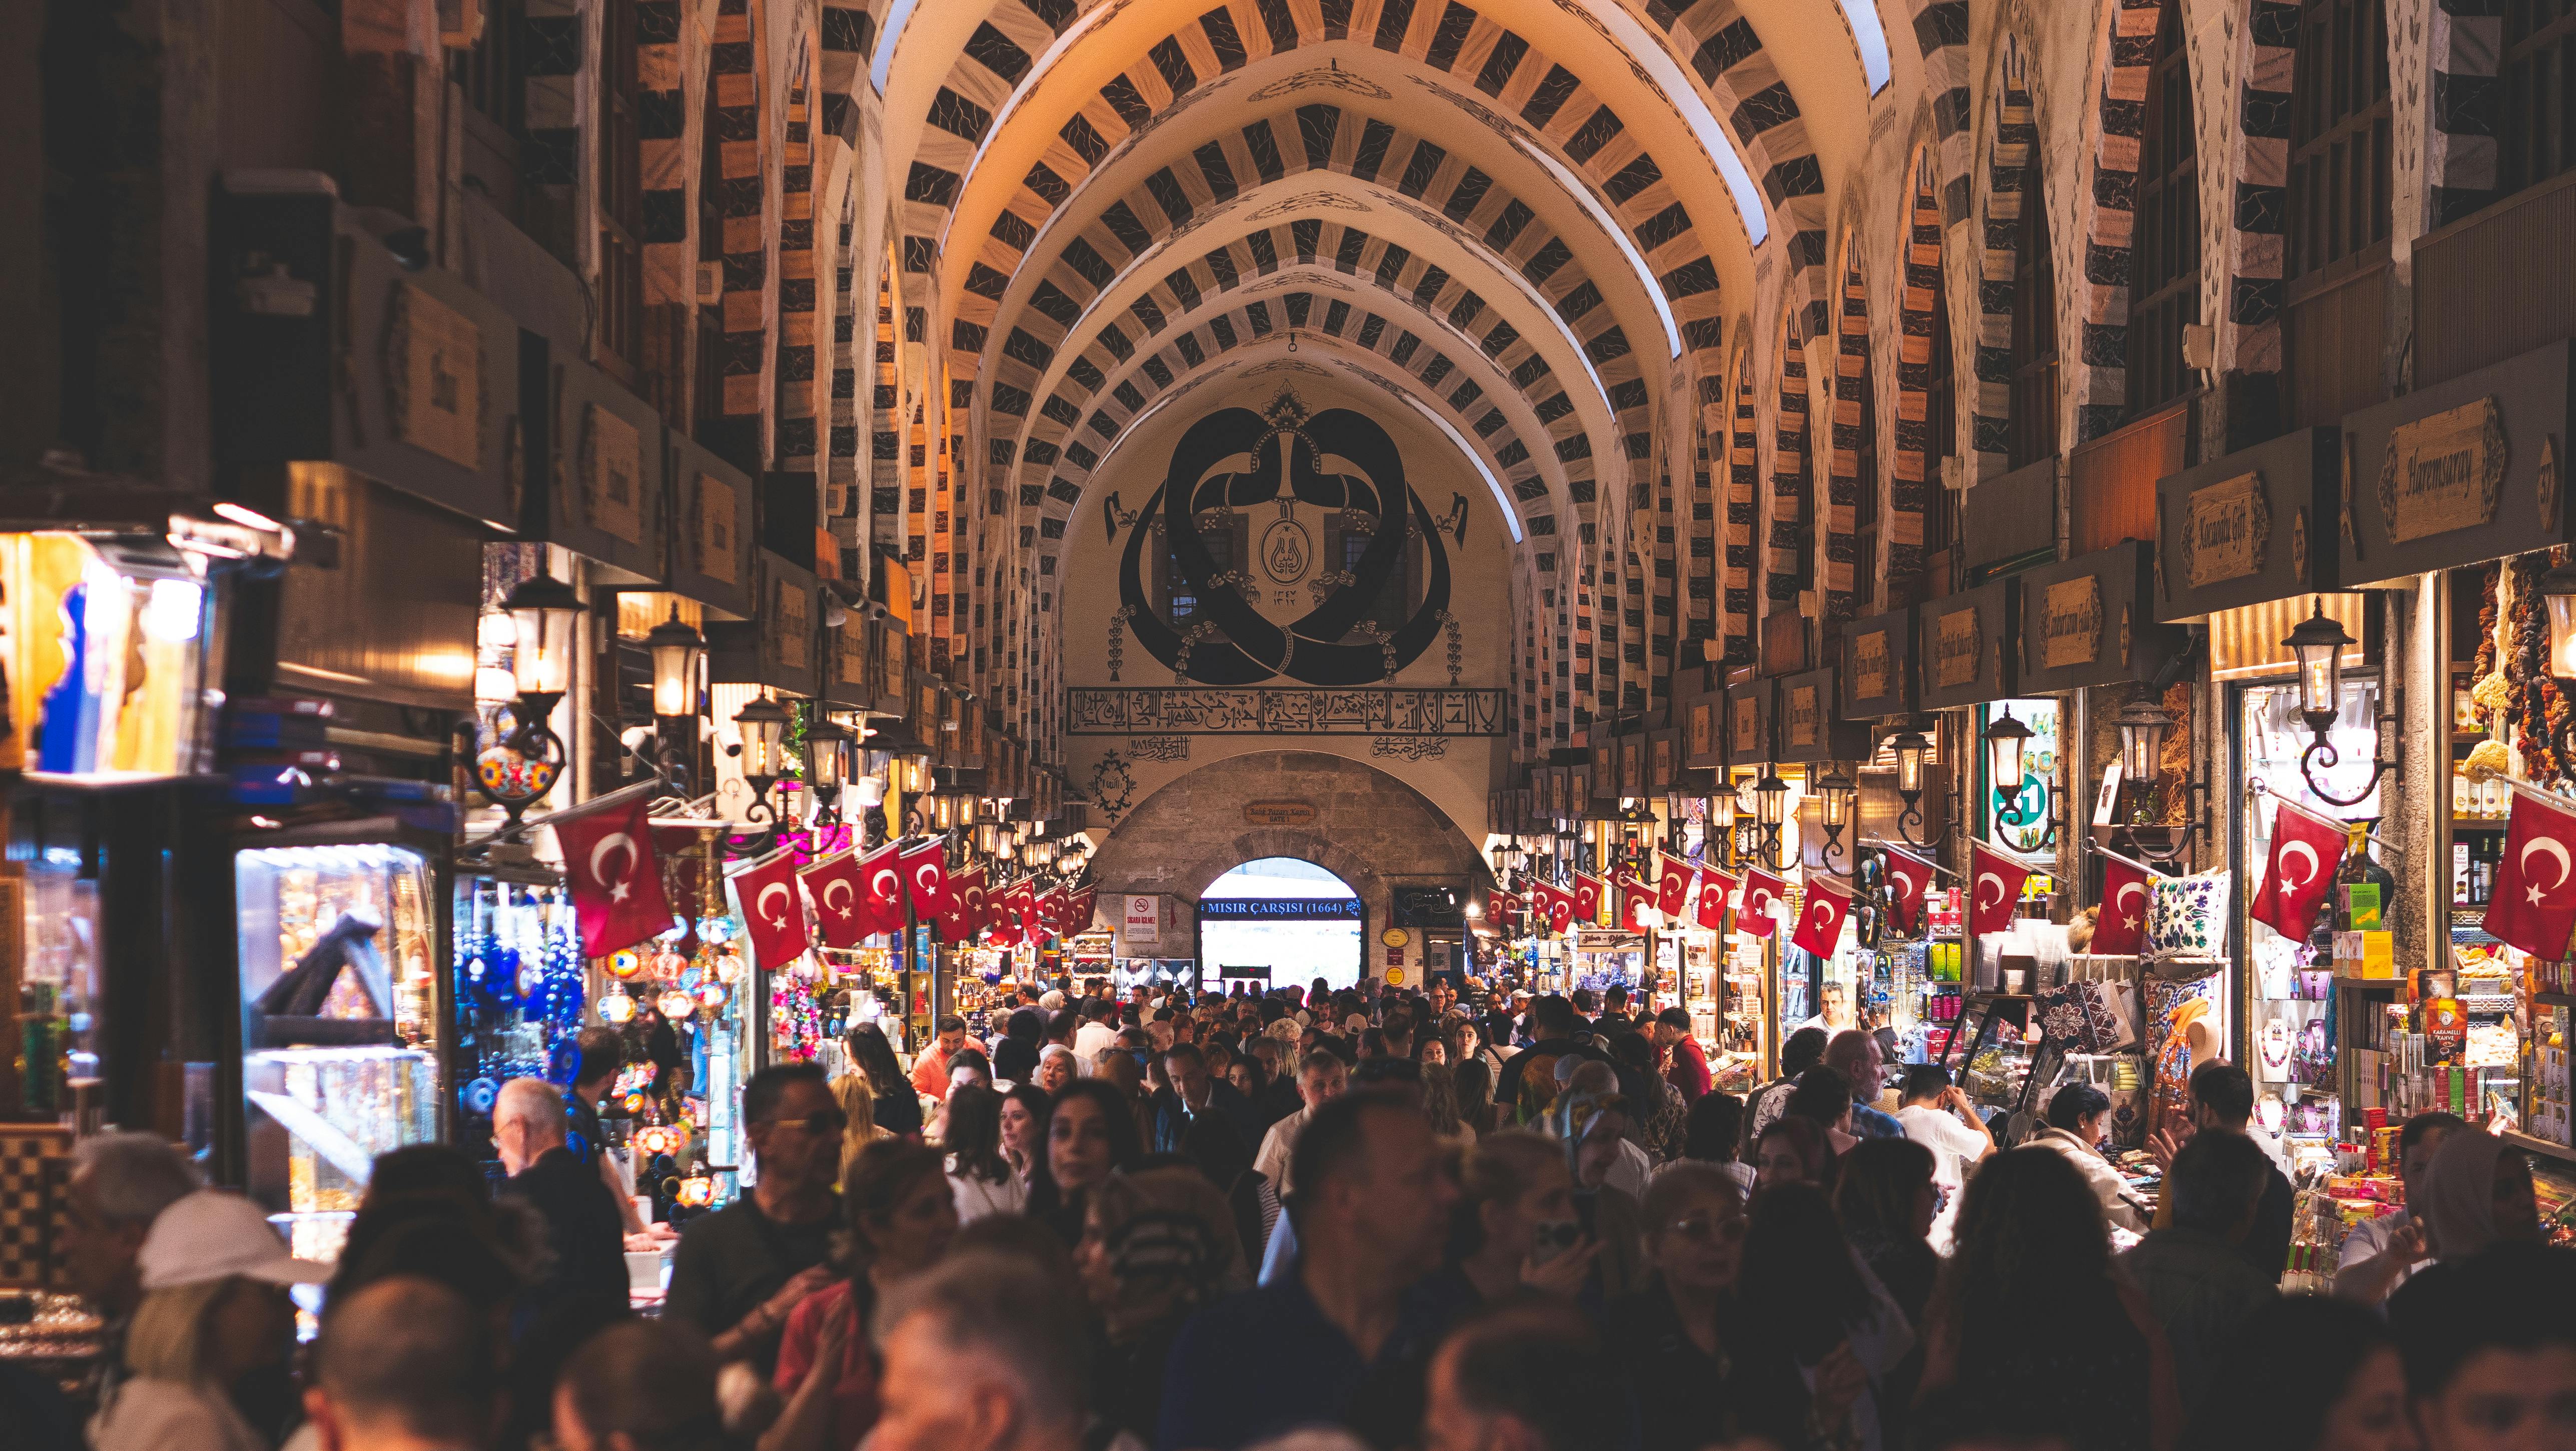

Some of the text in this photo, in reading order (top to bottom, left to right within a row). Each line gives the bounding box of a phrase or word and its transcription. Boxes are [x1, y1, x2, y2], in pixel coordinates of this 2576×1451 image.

[2406, 447, 2472, 498] Haremsaray
[2540, 462, 2551, 503] 37
[2232, 498, 2246, 554] Gift
[2295, 529, 2302, 561] 35
[1127, 915, 1155, 924] SİGARA İÇİLMEZ
[1208, 902, 1343, 916] MISIR ÇARŞISI (1664)
[1582, 935, 1601, 944] Silver
